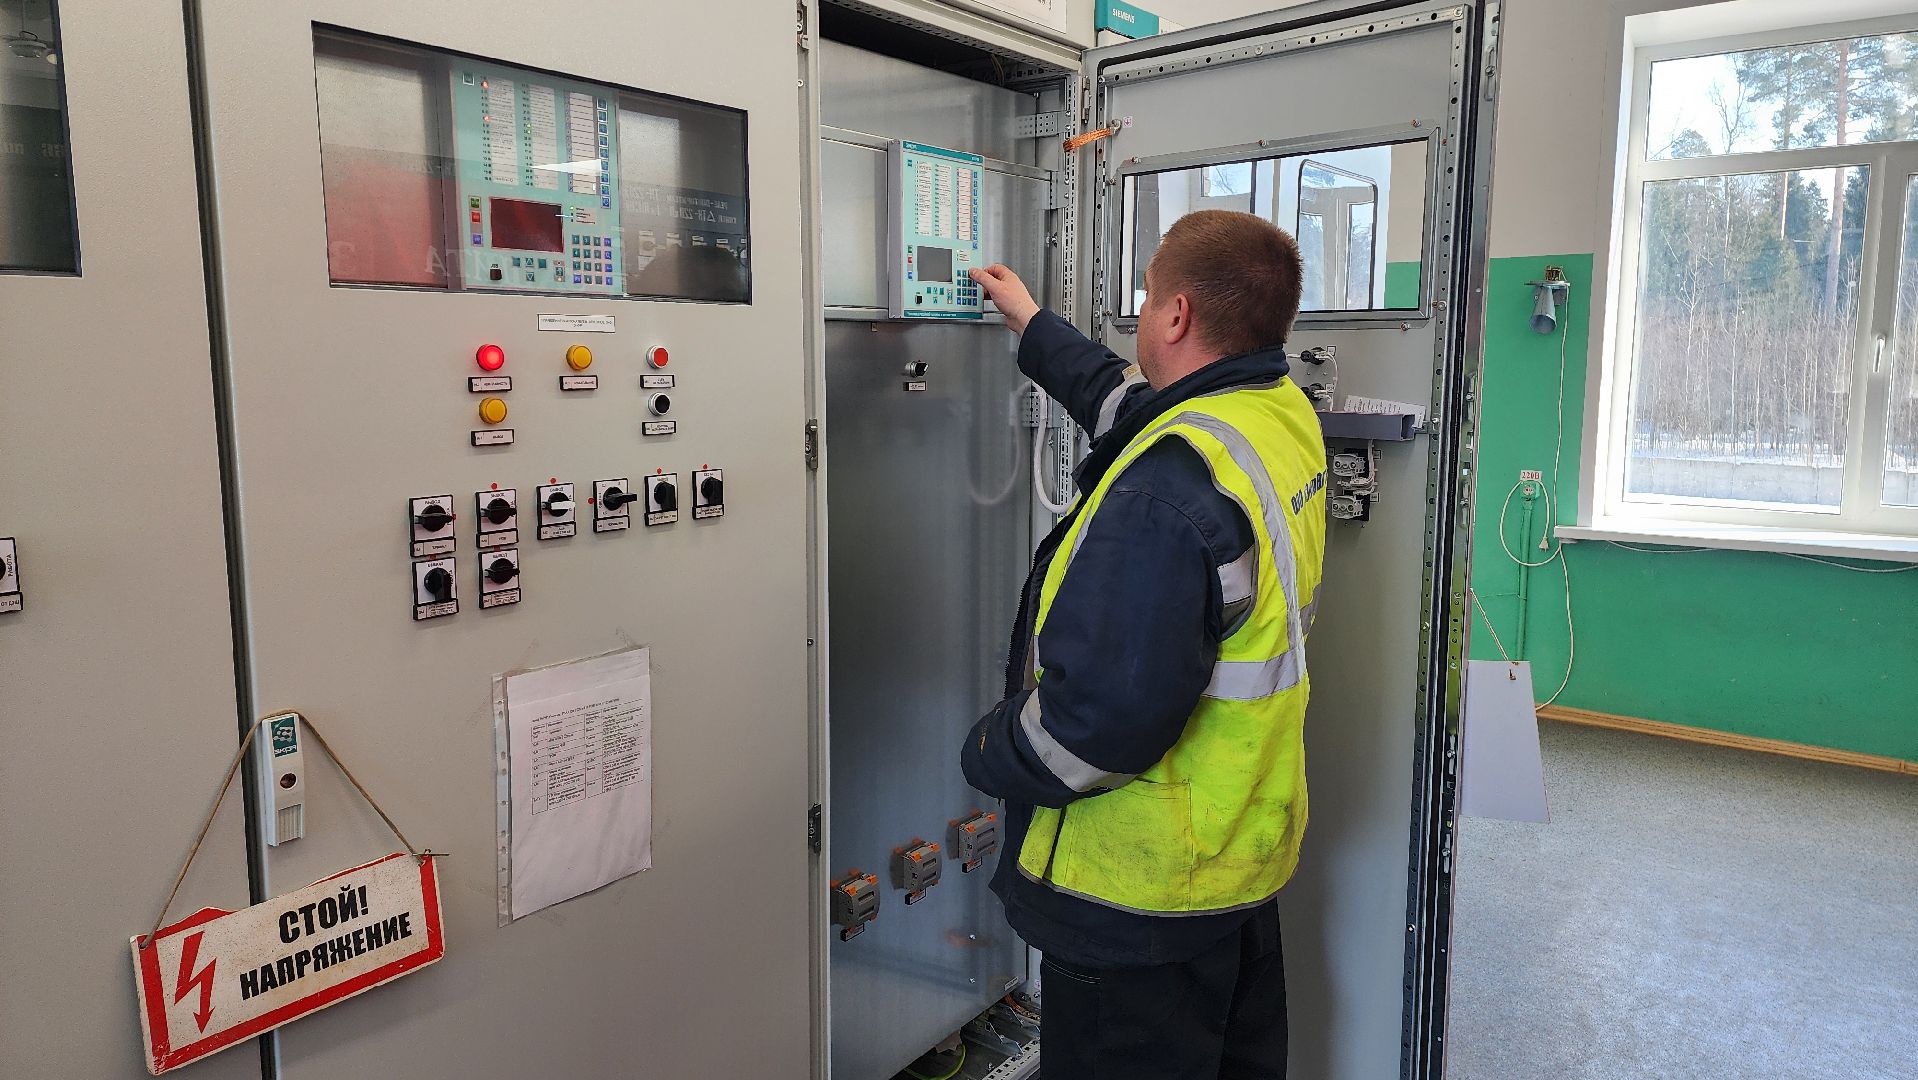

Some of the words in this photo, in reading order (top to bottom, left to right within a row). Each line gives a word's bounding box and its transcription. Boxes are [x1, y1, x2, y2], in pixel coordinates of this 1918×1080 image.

[1112, 8, 1135, 24] SIEMENS
[1521, 471, 1540, 480] 220В
[278, 884, 369, 945] СТОЙ!
[239, 911, 413, 1001] НАПРЯЖЕНИЕ
